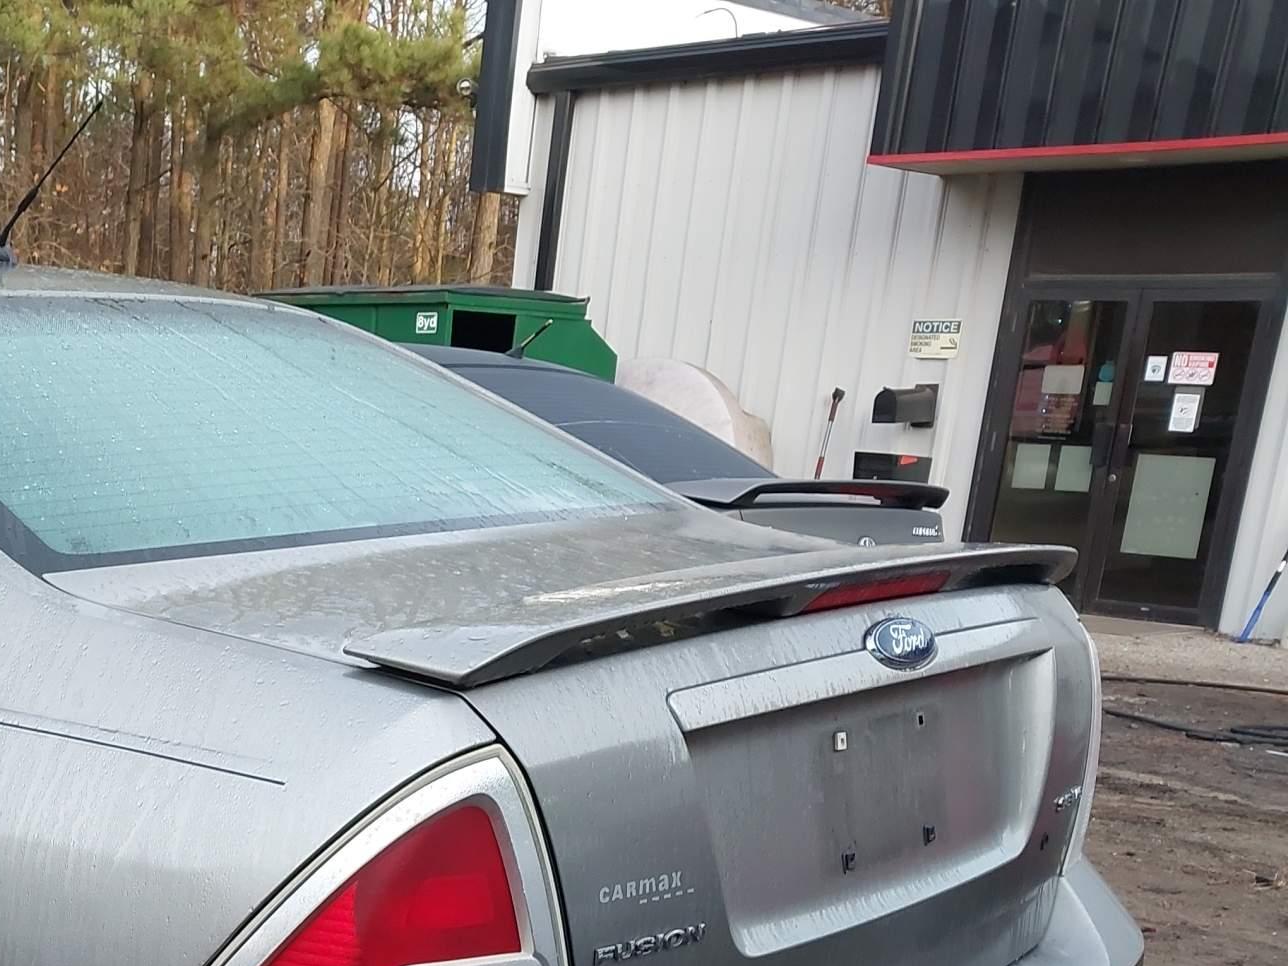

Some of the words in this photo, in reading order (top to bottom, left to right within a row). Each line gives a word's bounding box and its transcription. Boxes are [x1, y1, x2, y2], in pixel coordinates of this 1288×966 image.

[418, 316, 438, 330] 8yd
[914, 322, 959, 333] NOTICE
[1173, 353, 1189, 368] NO
[889, 623, 927, 655] Ford
